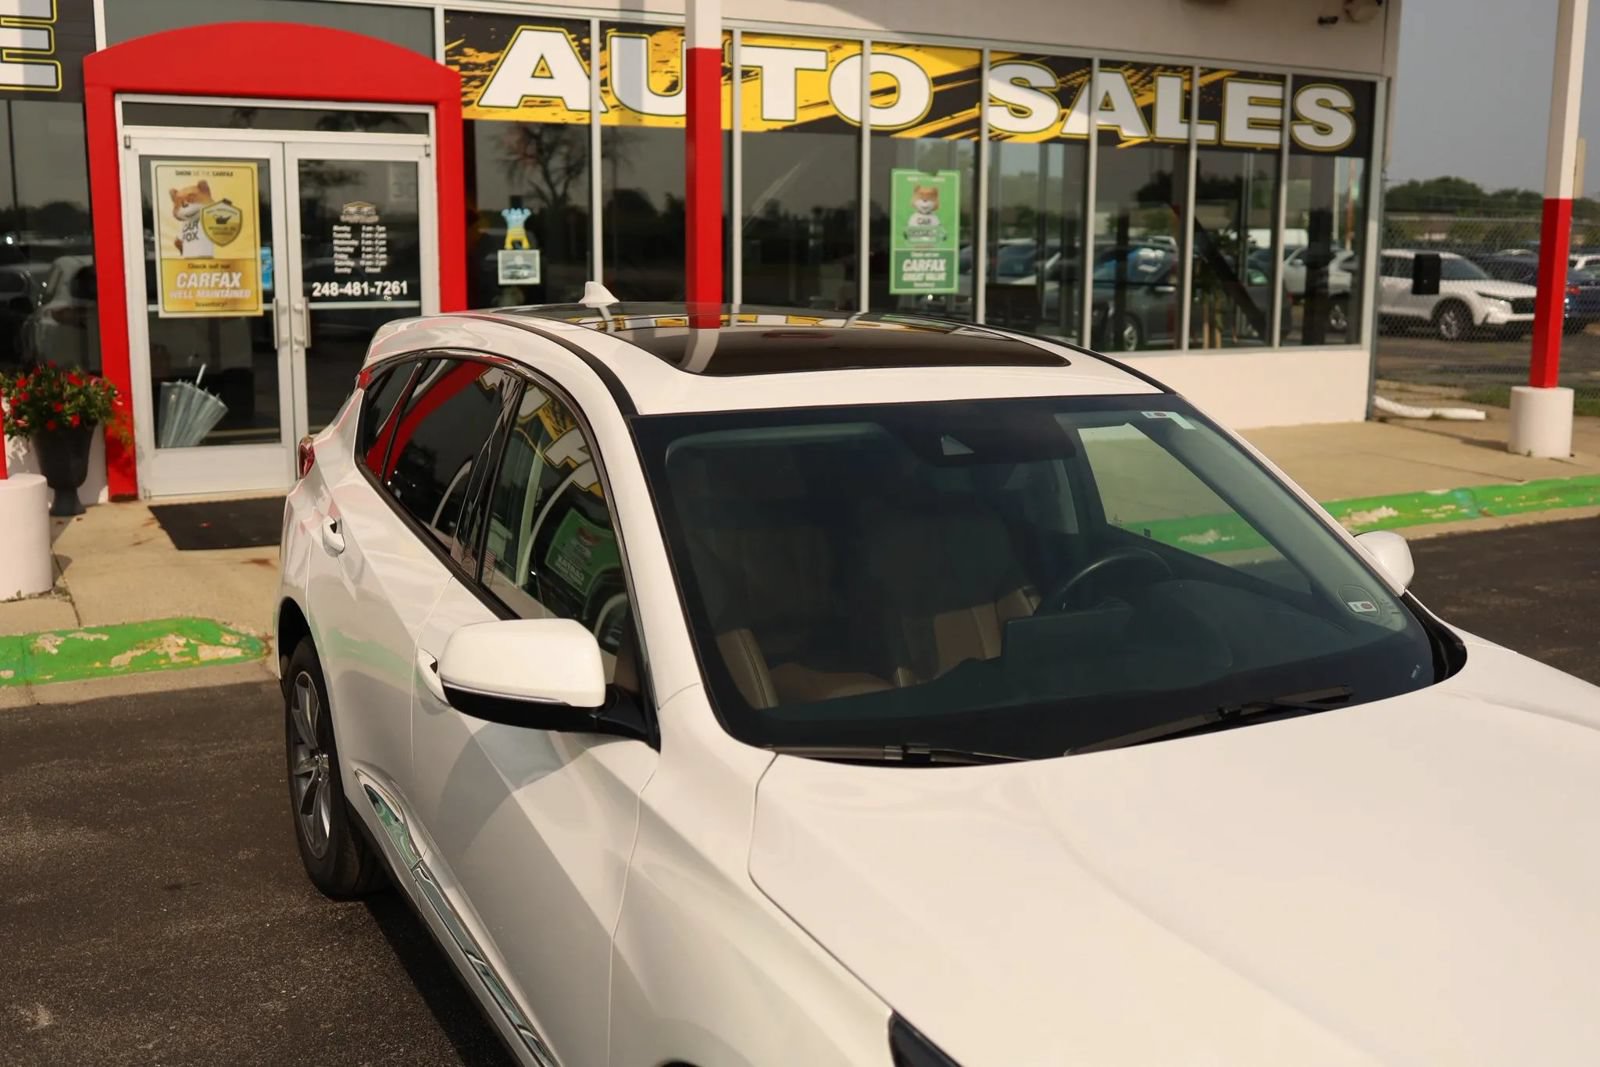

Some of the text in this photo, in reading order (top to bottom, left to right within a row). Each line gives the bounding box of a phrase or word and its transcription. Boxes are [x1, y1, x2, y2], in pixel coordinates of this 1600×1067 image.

[477, 25, 1355, 152] AUTO SALES
[902, 258, 946, 272] CARFAX
[176, 272, 242, 288] CARFAX
[169, 289, 251, 298] WELL MAINTAINED
[312, 281, 408, 297] 248-481-7261
